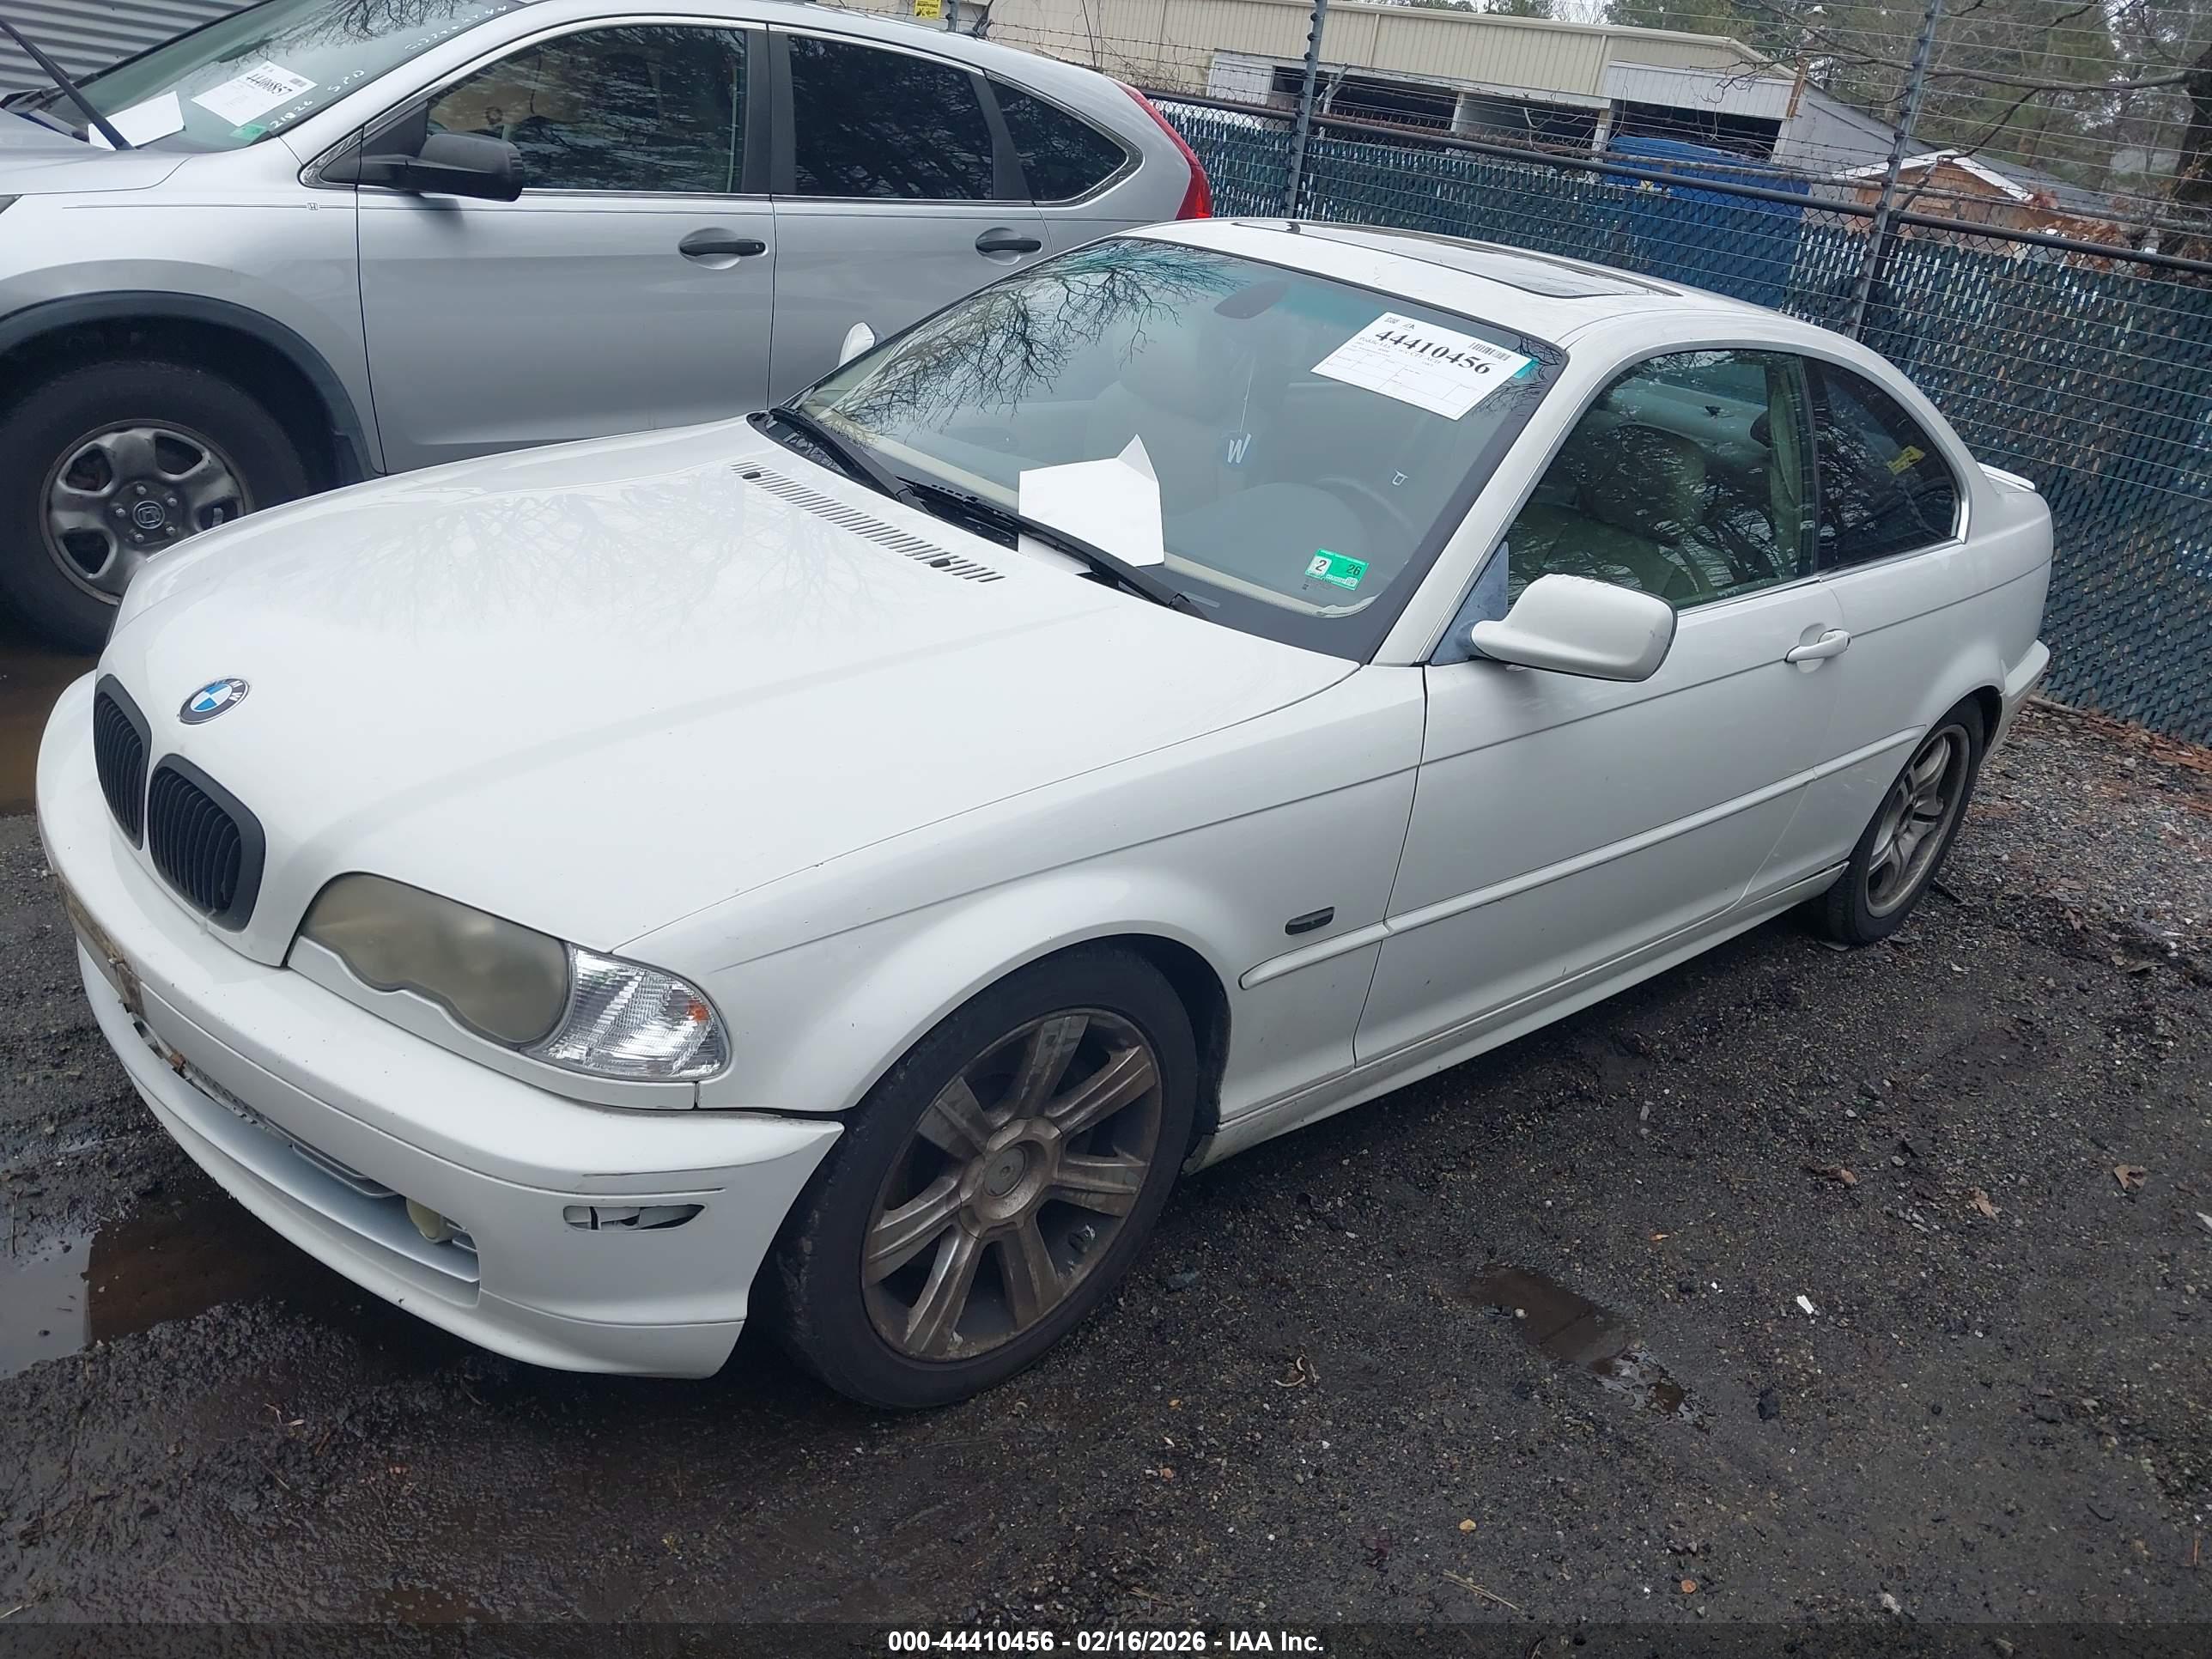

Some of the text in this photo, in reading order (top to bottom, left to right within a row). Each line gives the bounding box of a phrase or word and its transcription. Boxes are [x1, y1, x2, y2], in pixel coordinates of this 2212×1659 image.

[1375, 331, 1496, 374] 44410456
[1227, 433, 1251, 464] W
[1316, 559, 1362, 575] 2 26
